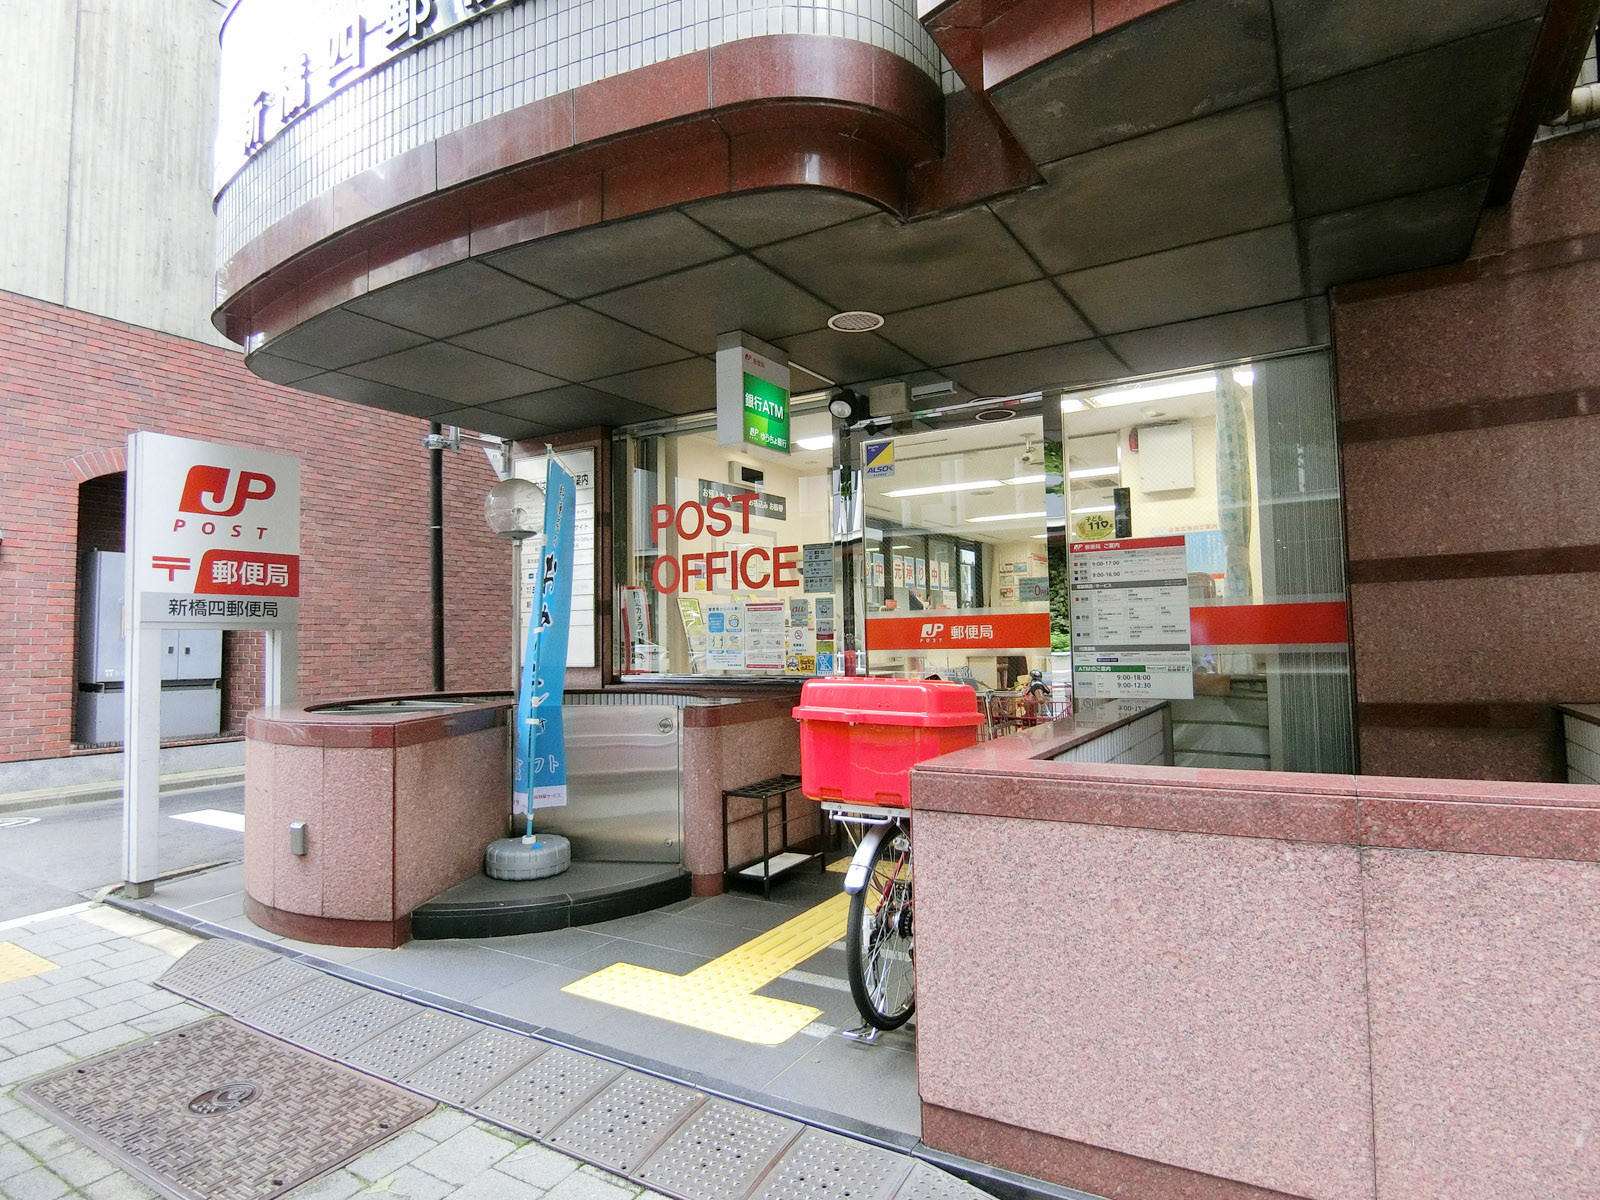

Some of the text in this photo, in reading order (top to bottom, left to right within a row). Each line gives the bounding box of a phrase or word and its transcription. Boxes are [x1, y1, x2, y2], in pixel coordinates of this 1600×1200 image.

[745, 392, 783, 419] 銀行ATM
[760, 432, 786, 448] ゆうちょ銀行
[867, 465, 894, 474] ALSOK
[173, 518, 268, 540] POST
[651, 493, 760, 543] POST
[212, 559, 290, 588] 郵便局
[652, 545, 800, 595] OFFICE
[168, 598, 278, 618] 新橋四郵便局
[950, 625, 994, 640] 郵便局
